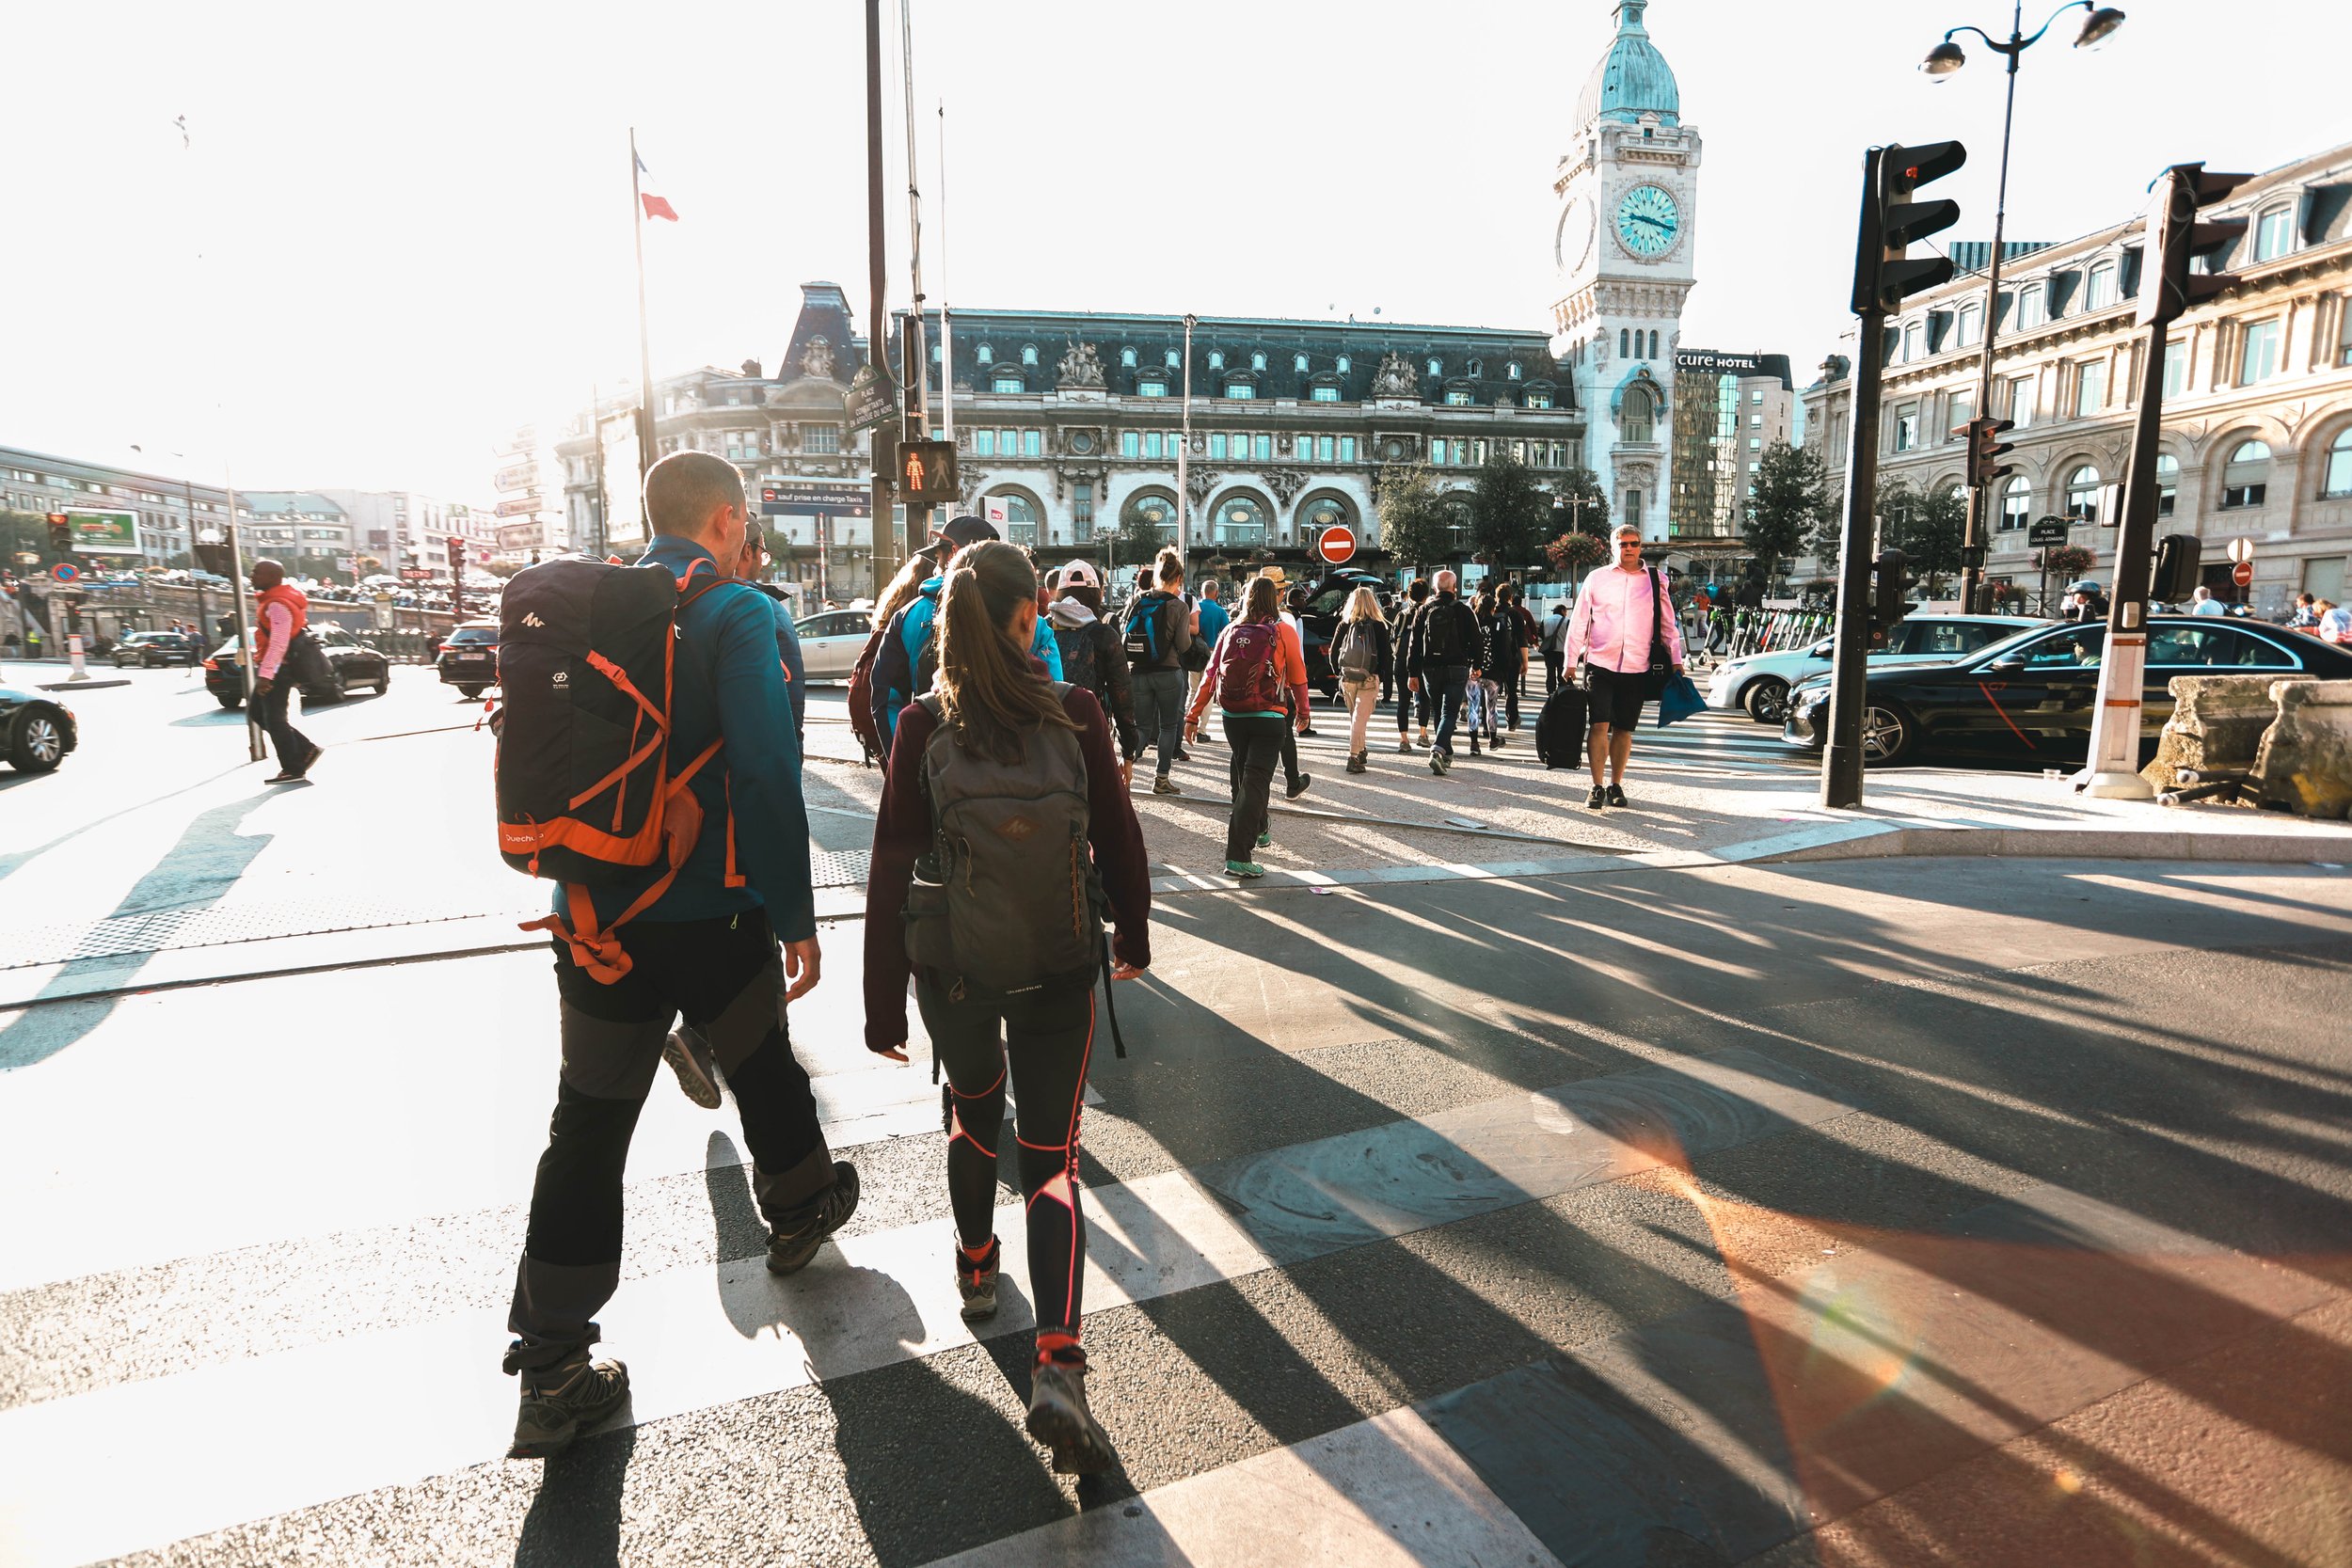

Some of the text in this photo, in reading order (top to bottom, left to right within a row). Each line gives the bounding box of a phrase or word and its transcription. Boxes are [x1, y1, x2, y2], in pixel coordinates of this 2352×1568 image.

[861, 387, 875, 399] PLACE
[850, 419, 856, 428] EN
[873, 408, 881, 418] DU
[880, 404, 893, 415] NORD
[793, 494, 811, 502] prise
[822, 494, 846, 503] charge
[846, 495, 864, 503] Taxis
